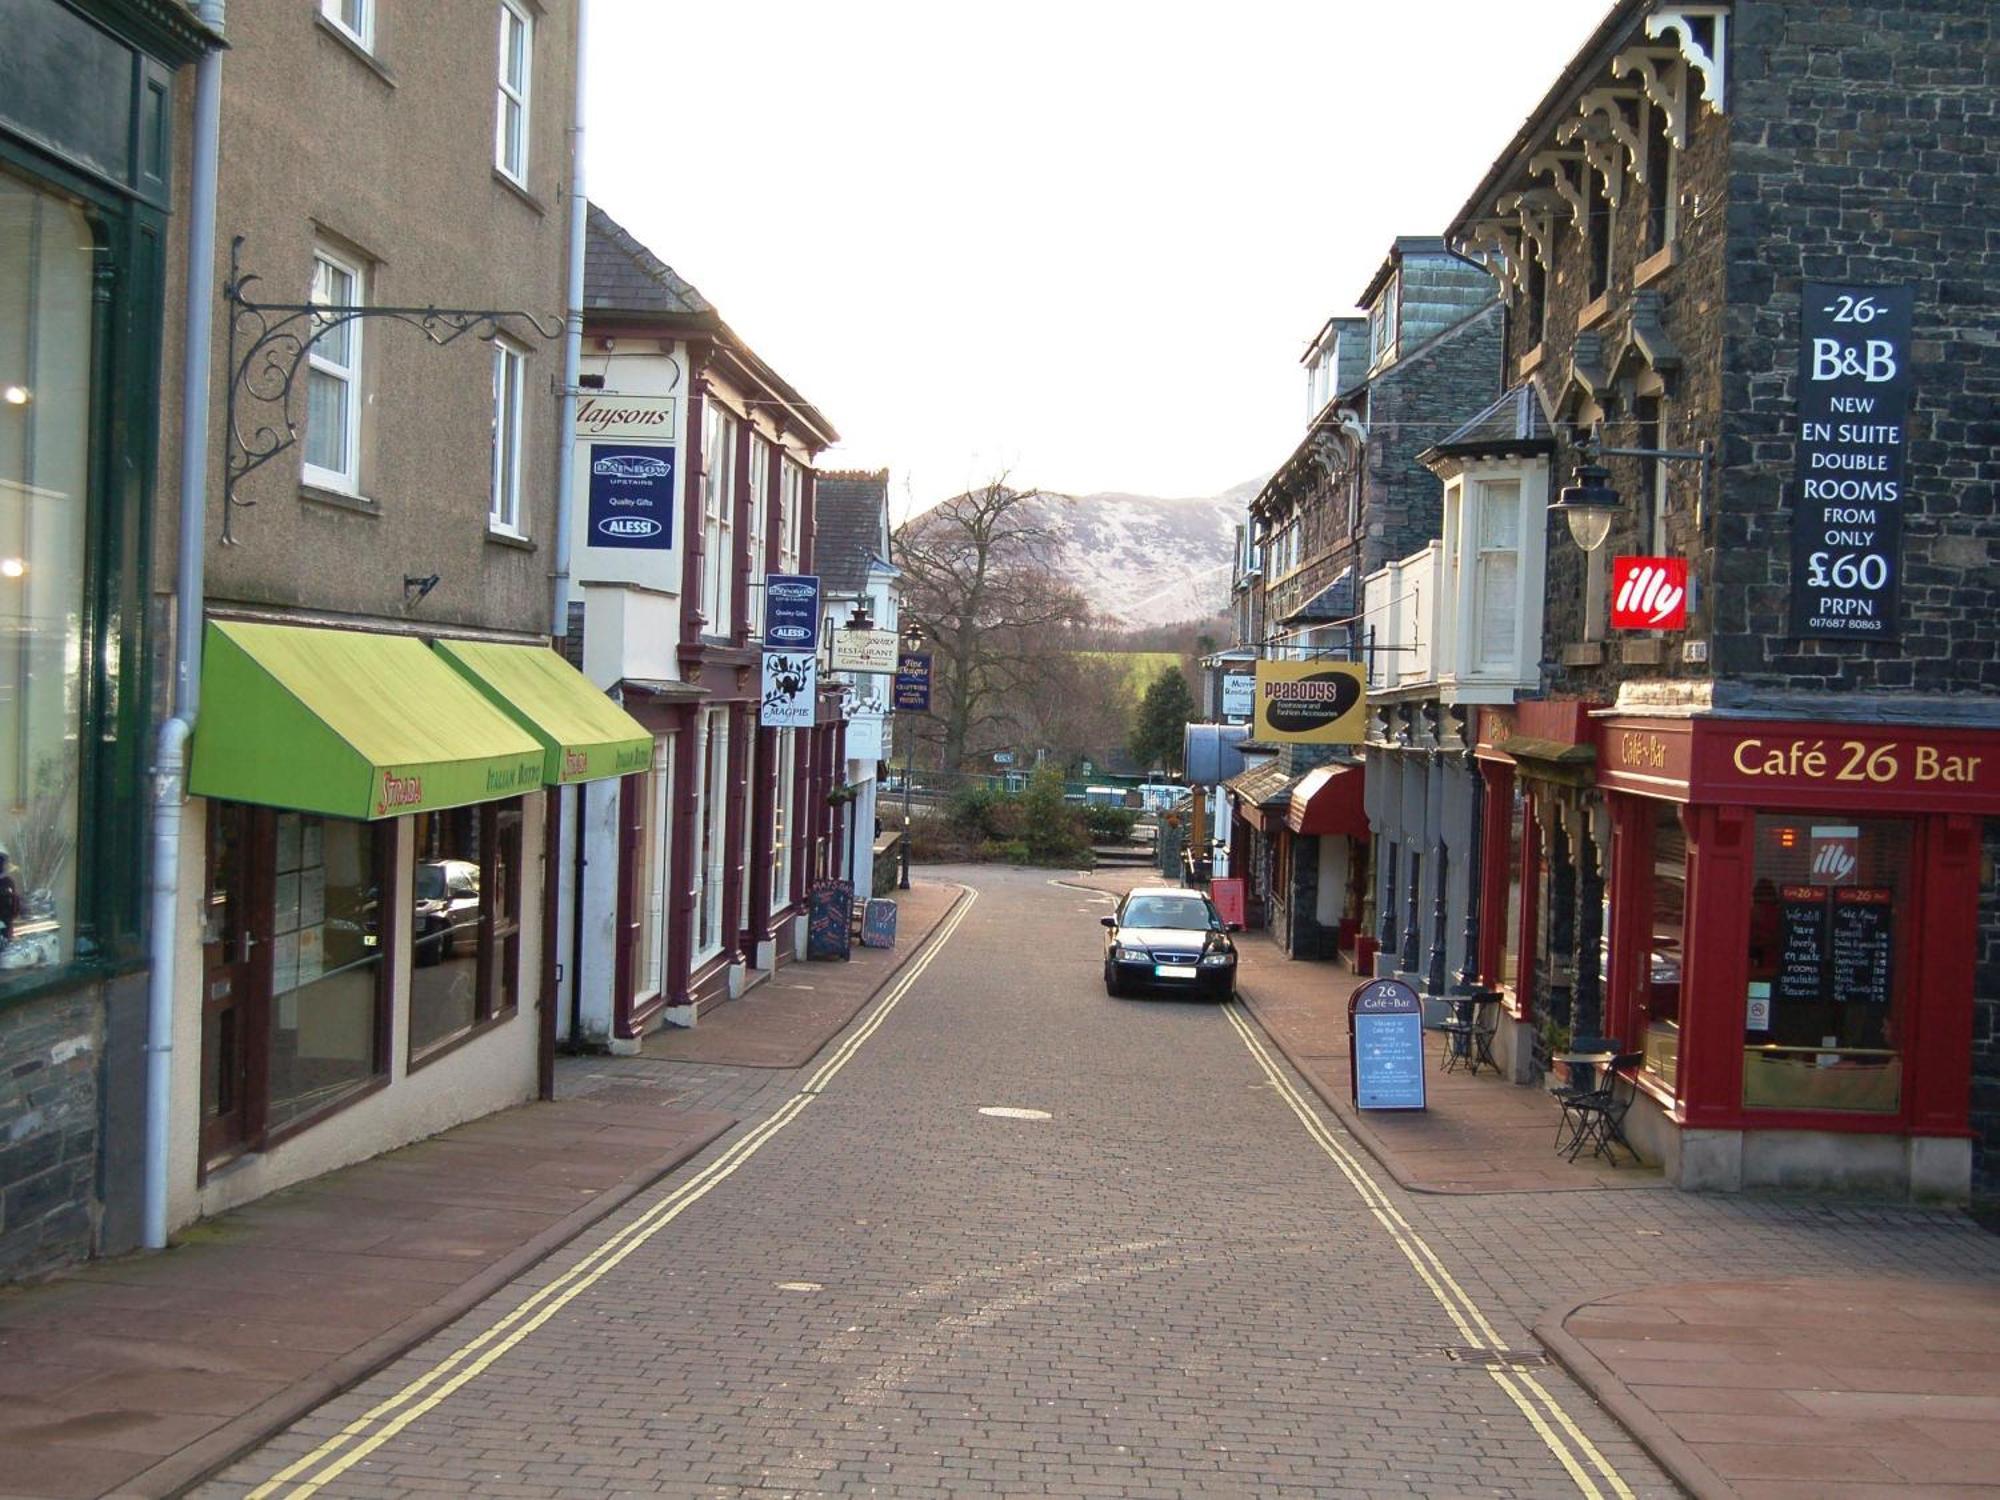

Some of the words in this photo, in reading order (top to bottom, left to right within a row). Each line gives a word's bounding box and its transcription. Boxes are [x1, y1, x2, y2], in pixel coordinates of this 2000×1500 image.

[1811, 338, 1897, 383] B&B
[1830, 397, 1874, 414] NEW
[1802, 424, 1831, 442] EN
[1839, 425, 1899, 444] SUITE
[1811, 453, 1888, 470] DOUBLE
[1804, 480, 1898, 501] ROOMS
[1823, 508, 1876, 524] FROM
[609, 521, 651, 533] ALESSI
[1825, 530, 1874, 546] ONLY
[1807, 552, 1888, 591] £60
[1616, 566, 1683, 623] illy
[1819, 598, 1873, 616] PRPN
[1810, 617, 1846, 629] 017687
[1848, 618, 1881, 630] 80863
[764, 708, 809, 718] MAGPIE
[1733, 740, 1827, 777] Café
[1836, 741, 1898, 781] 26
[1915, 746, 1981, 782] Bar
[1813, 844, 1855, 880] illy
[1798, 888, 1811, 898] 26
[1856, 889, 1871, 899] 26
[1378, 986, 1396, 997] 26
